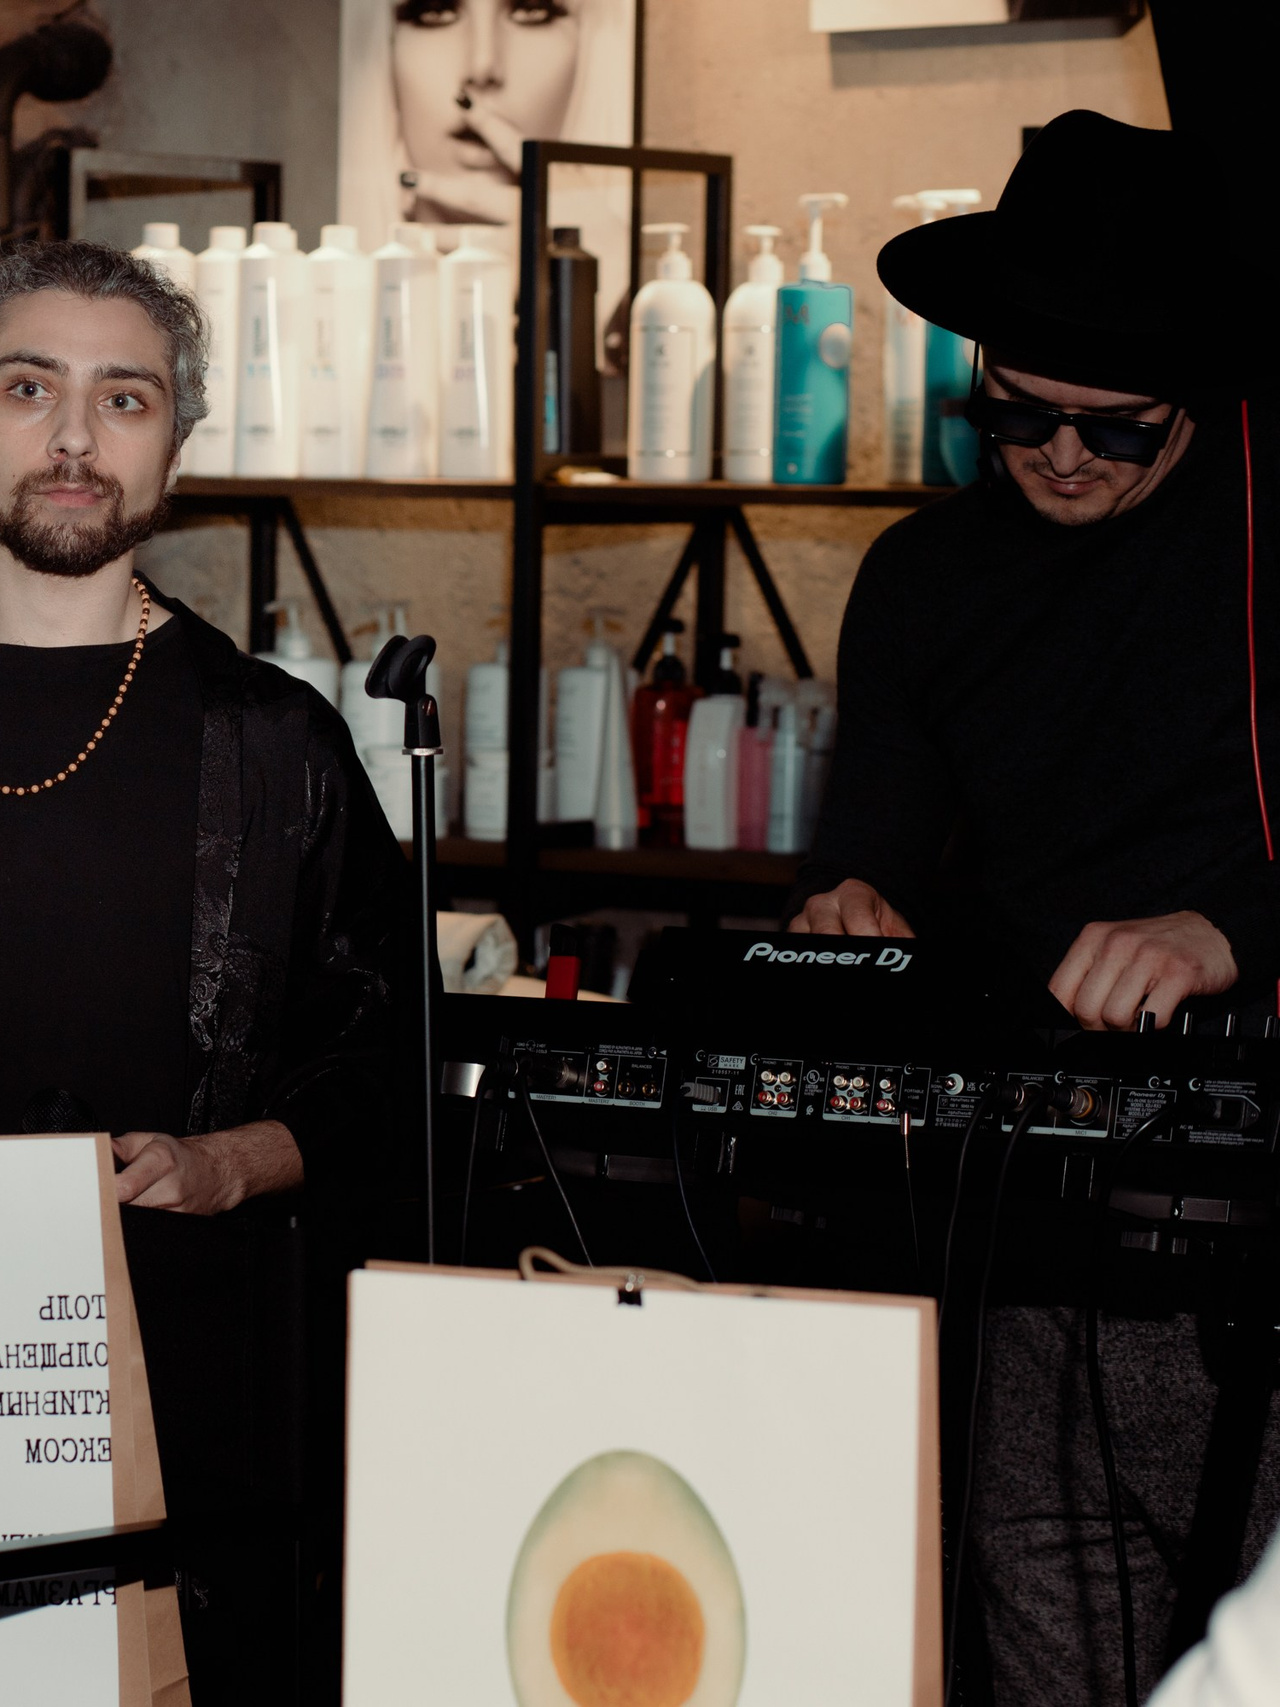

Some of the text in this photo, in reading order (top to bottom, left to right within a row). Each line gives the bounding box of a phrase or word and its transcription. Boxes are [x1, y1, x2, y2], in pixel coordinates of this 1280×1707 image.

[743, 942, 913, 973] Pioneer DJ
[720, 1056, 744, 1064] SAFETY
